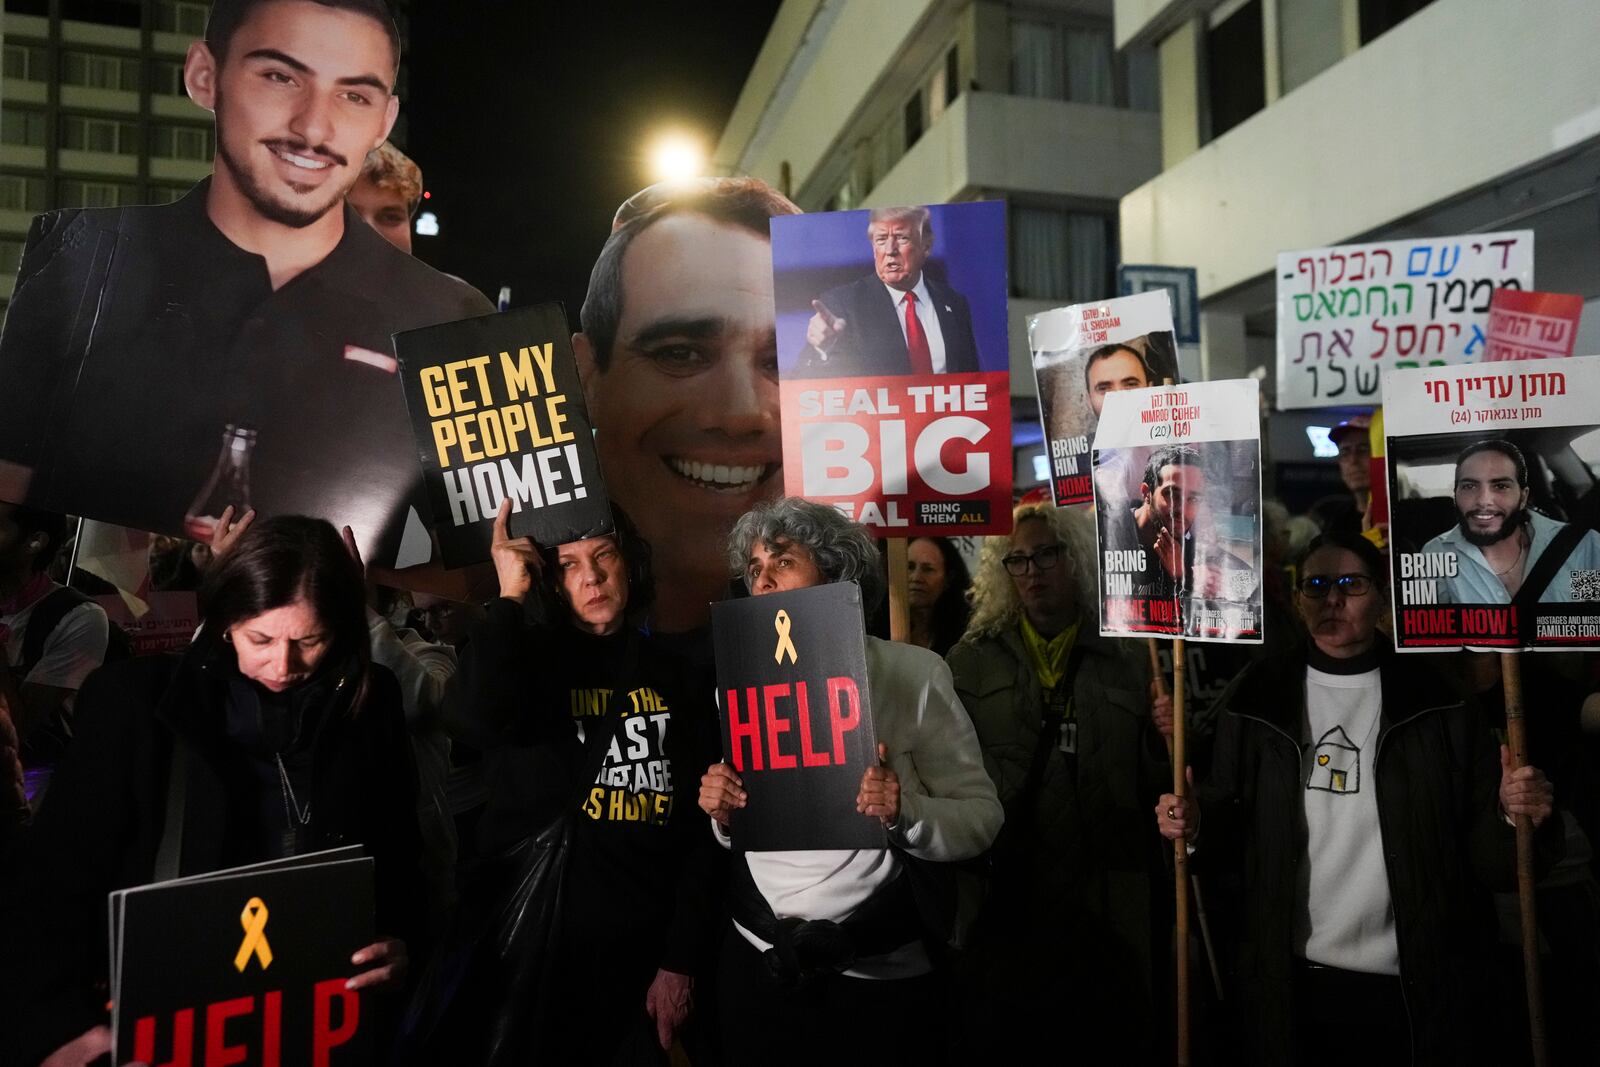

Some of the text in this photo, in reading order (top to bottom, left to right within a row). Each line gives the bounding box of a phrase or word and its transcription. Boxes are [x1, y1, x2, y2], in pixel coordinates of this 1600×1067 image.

[1407, 244, 1461, 277] עם
[1472, 239, 1518, 271] די
[1293, 283, 1413, 321] החמאס
[1090, 317, 1121, 331] SHOHAM
[1535, 319, 1565, 342] עד
[1293, 328, 1355, 364] את
[419, 342, 557, 418] GET MY
[1424, 372, 1566, 406] מתן עדיין חי
[799, 384, 988, 417] SEAL THE
[1141, 406, 1200, 424] NIMROD COHEN
[1451, 407, 1542, 424] מתן צנגאוקר (24)
[431, 394, 575, 468] PEOPLE
[1150, 424, 1171, 440] (20)
[800, 416, 991, 497] BIG
[1051, 435, 1088, 458] BRING
[1054, 459, 1079, 477] HIM
[442, 443, 587, 527] HOME!
[1058, 475, 1092, 498] HOME
[833, 501, 909, 527] EAL
[921, 503, 961, 514] BRING
[921, 513, 985, 524] THEM ALL
[1104, 550, 1147, 573] BRING
[1400, 551, 1458, 578] BRING
[1105, 573, 1133, 596] HIM
[1401, 579, 1437, 605] HIM
[1403, 605, 1519, 636] HOME NOW!
[1536, 615, 1567, 625] HOSTAGES
[1568, 615, 1581, 625] AND
[1536, 624, 1577, 638] FAMILIES
[570, 687, 668, 718] UNT THE
[726, 676, 861, 772] HELP
